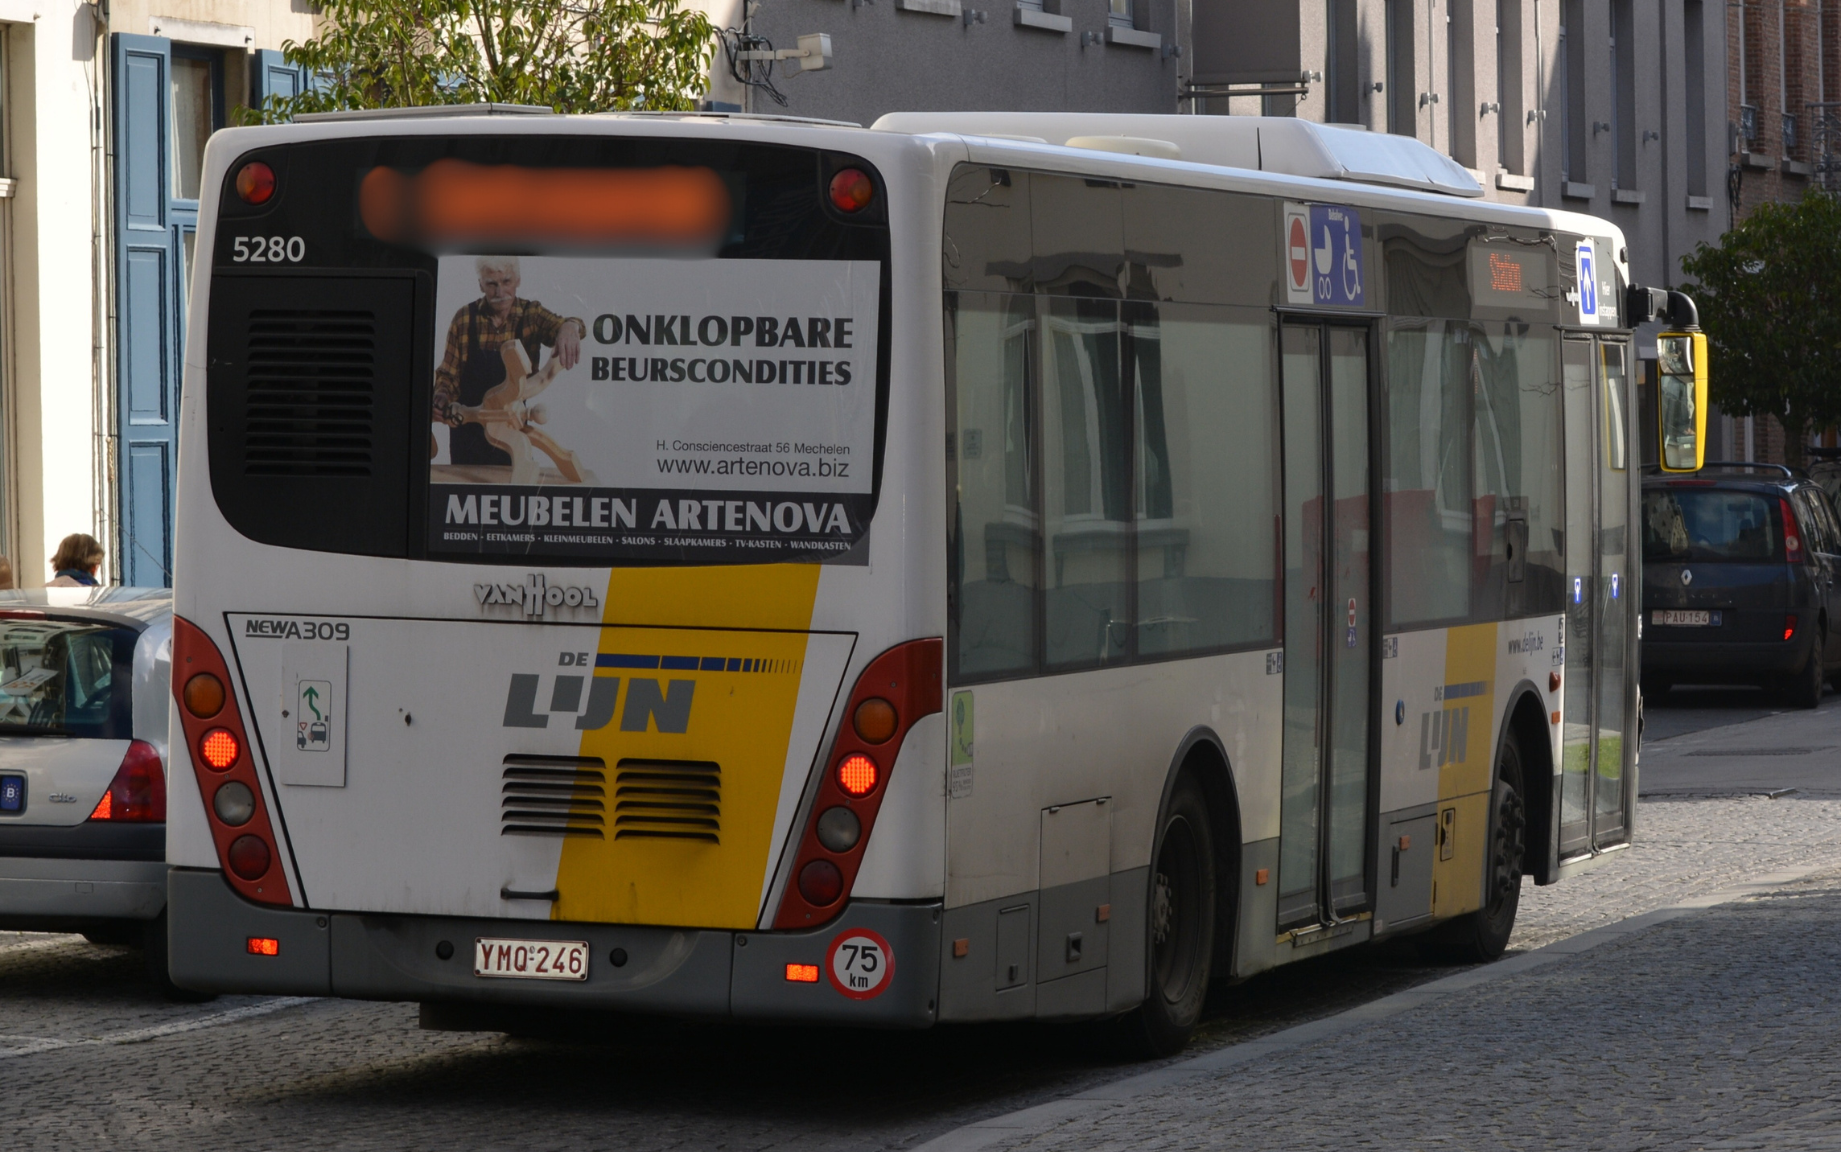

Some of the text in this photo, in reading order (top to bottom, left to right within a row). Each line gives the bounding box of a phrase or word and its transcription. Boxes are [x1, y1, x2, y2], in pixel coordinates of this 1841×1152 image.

[233, 236, 306, 262] 5280
[593, 314, 854, 348] ONKLOPBARE
[591, 356, 852, 386] BEURSCONDITIES
[656, 440, 850, 455] H. Consciencestraat 56 Mechelen
[657, 457, 850, 478] www.artenova.biz
[445, 494, 852, 534] MEUBELEN ARTENOVA
[443, 532, 852, 551] BEDDEN EETKAMERS KLEINMEUBELEN SALONS SLAAPKAMERS TV-KASTEN WANDKASTEN
[558, 652, 589, 666] DE
[503, 673, 697, 734] LIJN
[1434, 686, 1443, 701] DE
[1419, 706, 1470, 771] LIJN
[6, 787, 15, 798] B
[842, 944, 878, 973] 75
[849, 973, 869, 989] km
